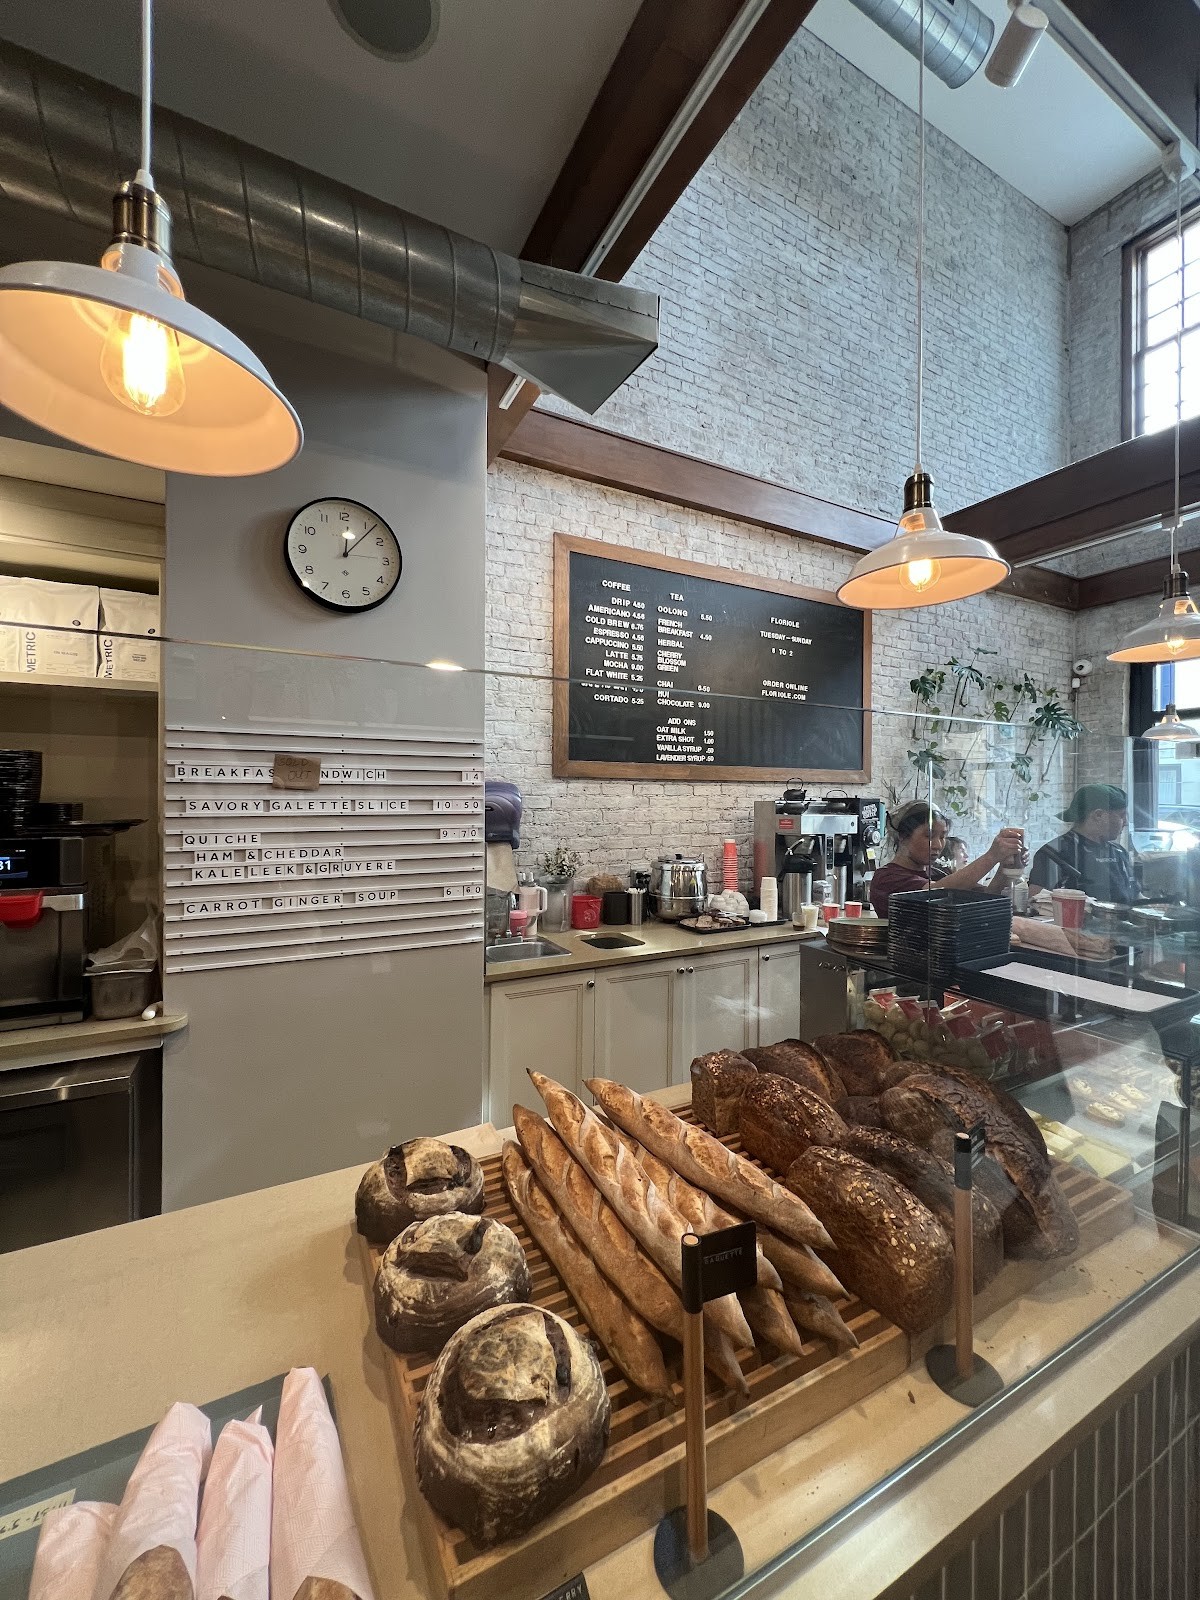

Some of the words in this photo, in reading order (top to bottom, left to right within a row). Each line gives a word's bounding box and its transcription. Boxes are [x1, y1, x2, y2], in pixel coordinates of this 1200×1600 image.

[320, 513, 328, 523] 11
[339, 511, 350, 522] 12
[304, 525, 316, 536] 10
[363, 521, 367, 530] 1
[375, 537, 384, 547] 2
[297, 544, 308, 554] 9
[381, 557, 390, 566] 3
[304, 565, 314, 574] 8
[376, 575, 385, 584] 4
[321, 581, 329, 590] 7
[601, 580, 631, 592] COFFEE
[341, 589, 351, 599] 6
[362, 586, 371, 596] 5
[611, 597, 631, 607] DRIP
[669, 592, 684, 602] TEA
[588, 604, 631, 618] AMERICANO
[657, 605, 688, 617] OOLONG
[585, 615, 606, 626] COLD
[607, 618, 630, 629] BREW
[657, 618, 683, 629] FRENCH
[770, 616, 800, 629] FLORIOLE
[593, 627, 630, 640] ESPRESSO
[657, 625, 694, 639] BREAKFAST
[585, 636, 630, 650] CAPPUCCINO
[657, 638, 685, 649] HERBAL
[25, 631, 37, 673] METRIC
[605, 650, 629, 660] LATTE
[657, 650, 683, 660] CHERRY
[779, 648, 787, 656] TO
[103, 639, 113, 679] METRIC
[657, 657, 687, 667] BLOSSOM
[604, 660, 629, 670] MOCHA
[656, 664, 679, 673] GREEN
[585, 668, 604, 678] FLAT
[606, 669, 629, 680] WHITE
[656, 680, 674, 689] CHAI
[762, 680, 784, 689] ORDER
[785, 682, 809, 692] ONLINE
[593, 693, 629, 704] CORTADO
[656, 698, 695, 708] CHOCOLATE
[667, 717, 681, 725] ADD
[683, 718, 697, 726] ONS
[656, 725, 669, 734] OAT
[670, 727, 687, 735] MILK
[656, 734, 678, 743] EXTRA
[678, 735, 695, 743] SHOT
[656, 743, 682, 752] VANILLA
[682, 745, 703, 753] SYRUP
[656, 753, 687, 762] LAVENDER
[177, 767, 275, 778] BREAKFAS
[321, 770, 385, 779] NDWICH
[189, 801, 261, 811] SAVORY
[272, 801, 349, 810] GALETTE
[358, 801, 407, 810] SLICE
[184, 834, 258, 845] QUICHE
[197, 851, 232, 862] HAM
[247, 850, 256, 860] &
[264, 848, 342, 860] CHEDDAR
[195, 868, 242, 879] KALE
[251, 865, 294, 876] LEEK
[305, 864, 313, 874] &
[319, 861, 393, 873] GRUYERE
[186, 900, 260, 914] CARROT
[274, 895, 341, 908] GINGER
[358, 891, 396, 902] SOUP
